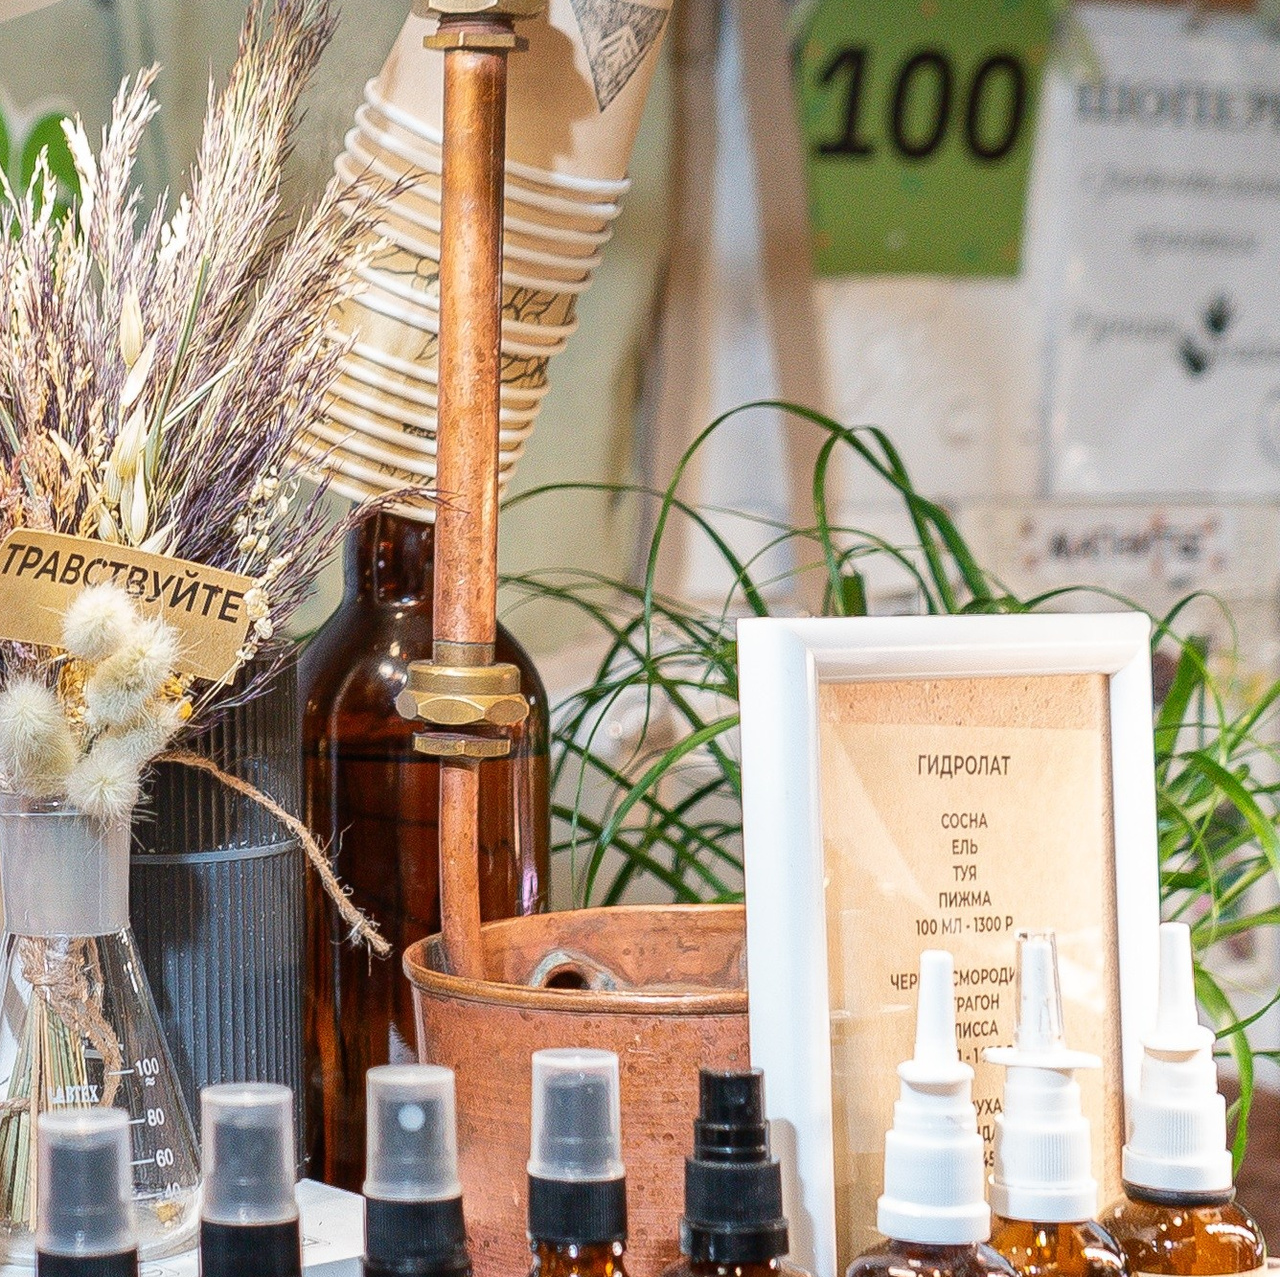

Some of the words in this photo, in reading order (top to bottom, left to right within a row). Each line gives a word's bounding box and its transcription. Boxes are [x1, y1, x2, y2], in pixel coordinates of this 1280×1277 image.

[816, 48, 1026, 160] 100
[1, 542, 246, 624] ТРАВСТВУЙТЕ
[917, 754, 1011, 779] ГИДРОЛАТ
[940, 813, 988, 829] СОСНА
[951, 839, 978, 855] ЕЛЬ
[952, 865, 977, 882] ТУЯ
[938, 891, 992, 909] ПИЖМА
[915, 919, 937, 936] 100
[941, 918, 962, 935] МЛ
[974, 917, 1001, 933] 1300
[1005, 916, 1013, 932] Р
[890, 973, 918, 991] ЧЕР
[135, 1057, 160, 1076] 100
[147, 1108, 164, 1126] 80
[156, 1148, 173, 1167] 60
